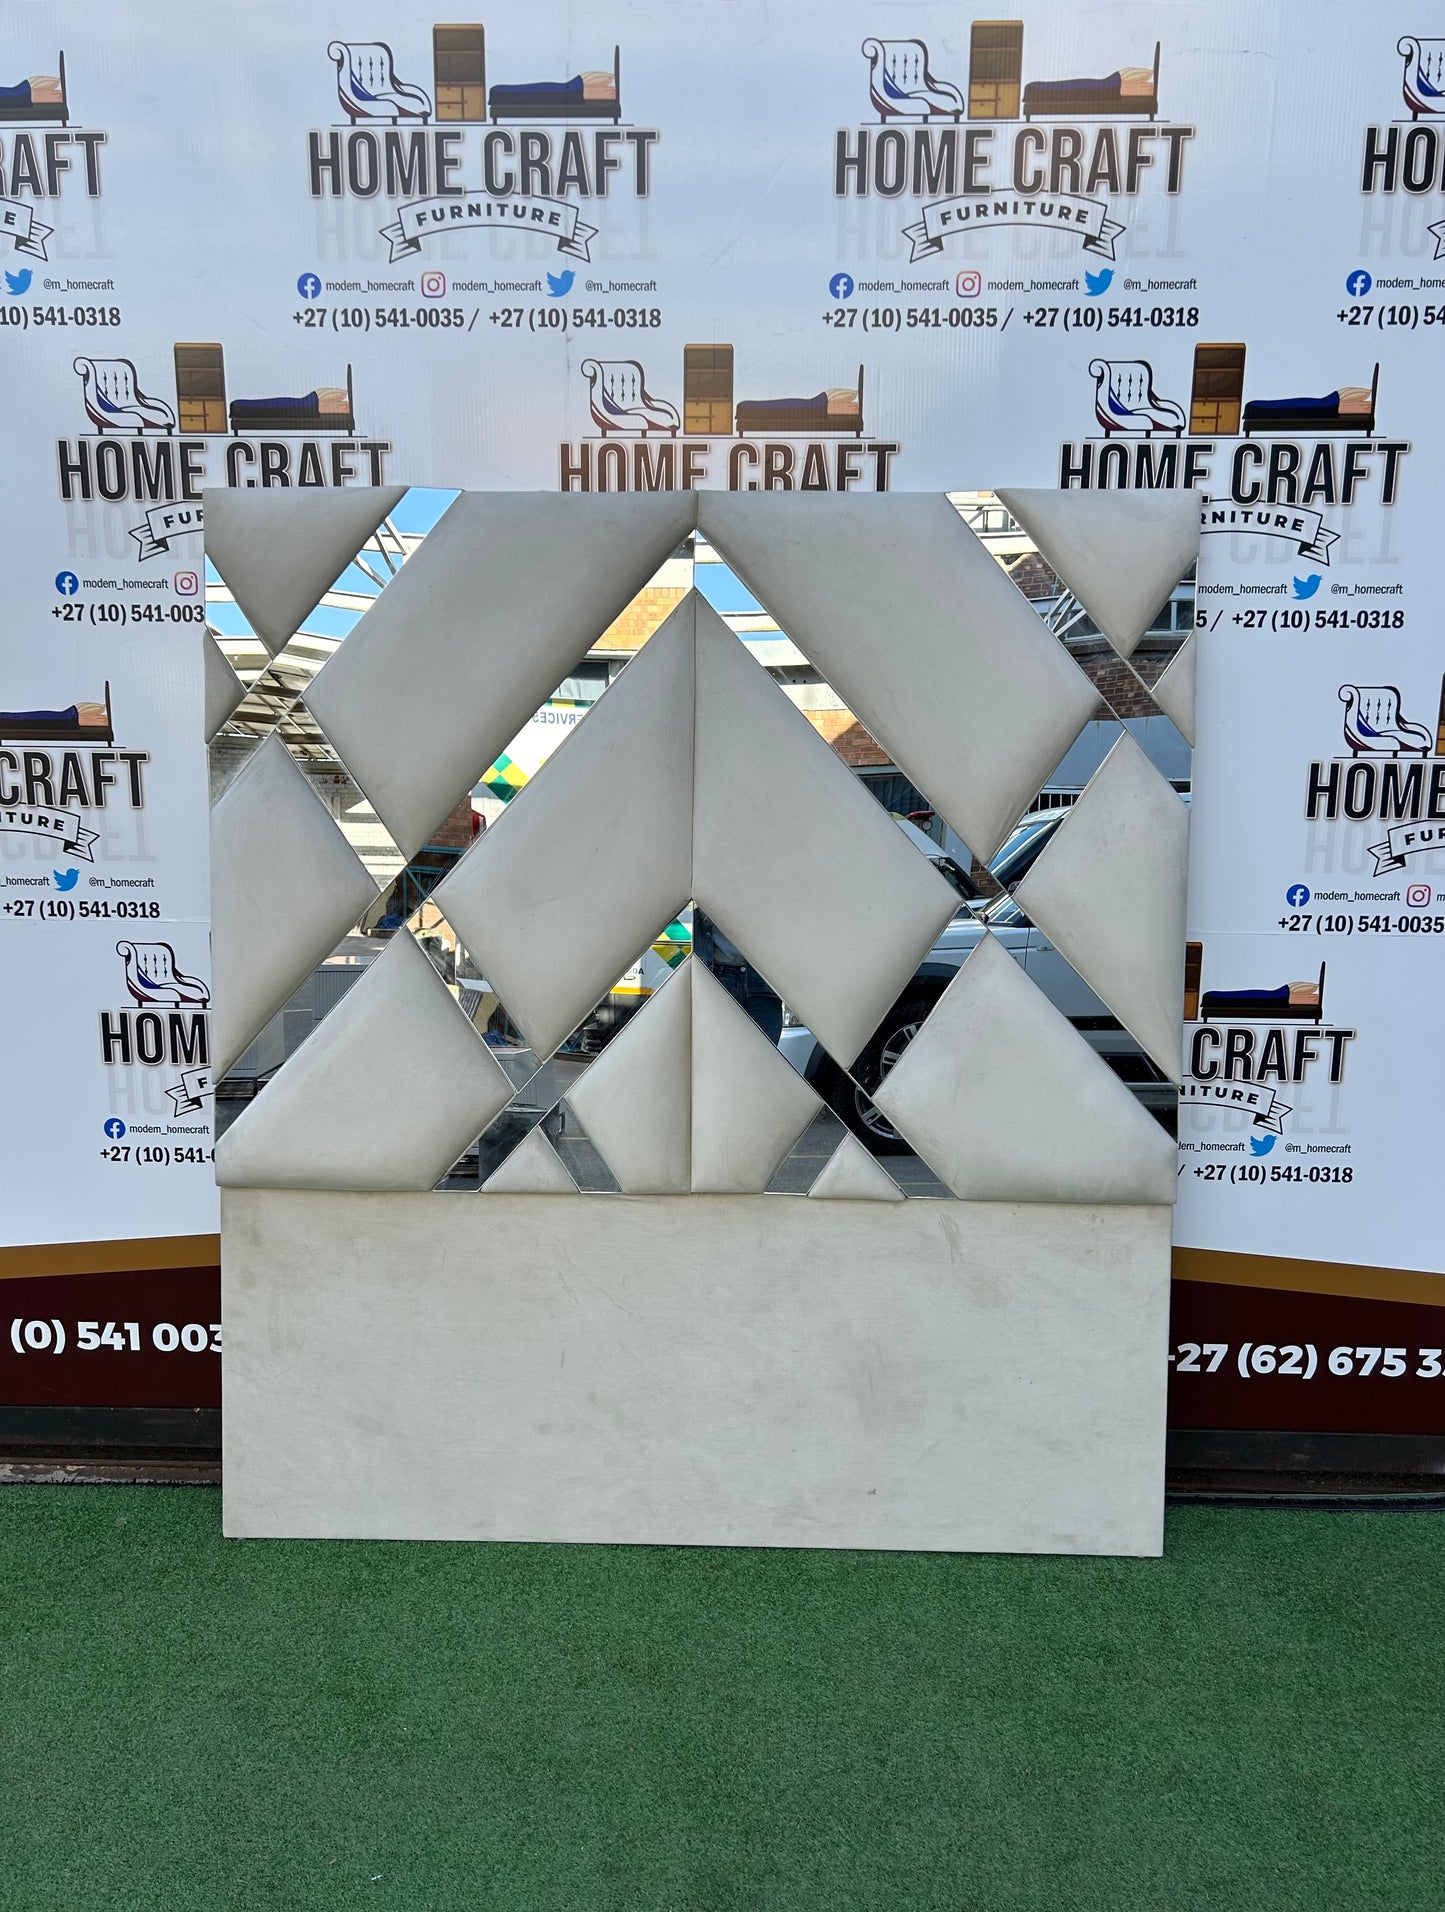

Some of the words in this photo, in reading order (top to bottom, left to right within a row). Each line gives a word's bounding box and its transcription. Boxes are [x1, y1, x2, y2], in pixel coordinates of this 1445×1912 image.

[308, 130, 465, 198] HOME
[483, 130, 659, 198] CRAFT
[834, 128, 995, 197] HOME
[1012, 126, 1195, 197] CRAFT
[1361, 125, 1445, 194] HO
[415, 203, 562, 227] FURNITURE
[940, 201, 1090, 226] FURNITURE
[43, 278, 115, 292] @m_homecraft
[585, 280, 658, 293] @m_homecraft
[1124, 279, 1198, 292] @m_homecraft
[33, 306, 121, 327] 541-0318
[293, 307, 328, 328] +27
[332, 307, 371, 332] (10)
[375, 307, 465, 328] 541-0035
[489, 307, 525, 328] +27
[529, 307, 568, 332] (10)
[572, 308, 662, 328] 541-0318
[822, 307, 858, 328] +27
[862, 307, 902, 332] (10)
[906, 307, 998, 328] 541-0035
[1023, 307, 1060, 328] +27
[1063, 307, 1103, 332] (10)
[1107, 306, 1200, 328] 541-0318
[1337, 305, 1374, 326] +27
[1378, 305, 1419, 330] (10)
[57, 439, 207, 502] HOME
[226, 440, 391, 488] CRAFT
[560, 442, 710, 491] HOME
[729, 442, 899, 491] CRAFT
[1231, 441, 1410, 506] CRAFT
[1331, 583, 1403, 597] @m_homecraft
[52, 603, 85, 622] +27
[89, 603, 127, 626] (10)
[1232, 610, 1268, 628] +27
[1271, 610, 1310, 632] (10)
[1314, 610, 1405, 629] 541-0318
[0, 750, 149, 808] CRAFT
[88, 877, 155, 889] @m_homecraft
[3, 900, 34, 917] +27
[39, 900, 75, 920] (10)
[79, 901, 161, 919] 541-0318
[1278, 914, 1313, 932] +27
[1316, 914, 1354, 935] (10)
[1357, 915, 1445, 933] 541-0035
[1190, 1026, 1354, 1083] CRAFT
[100, 1146, 131, 1162] +27
[135, 1146, 170, 1166] (10)
[1285, 1142, 1351, 1154] @m_homecraft
[1193, 1164, 1226, 1181] +27
[1230, 1165, 1266, 1184] (10)
[1270, 1165, 1353, 1183] 541-0318
[10, 1318, 66, 1355] (0)
[76, 1320, 141, 1351] 541
[1237, 1342, 1318, 1380] (62)
[1327, 1346, 1407, 1378] 675
